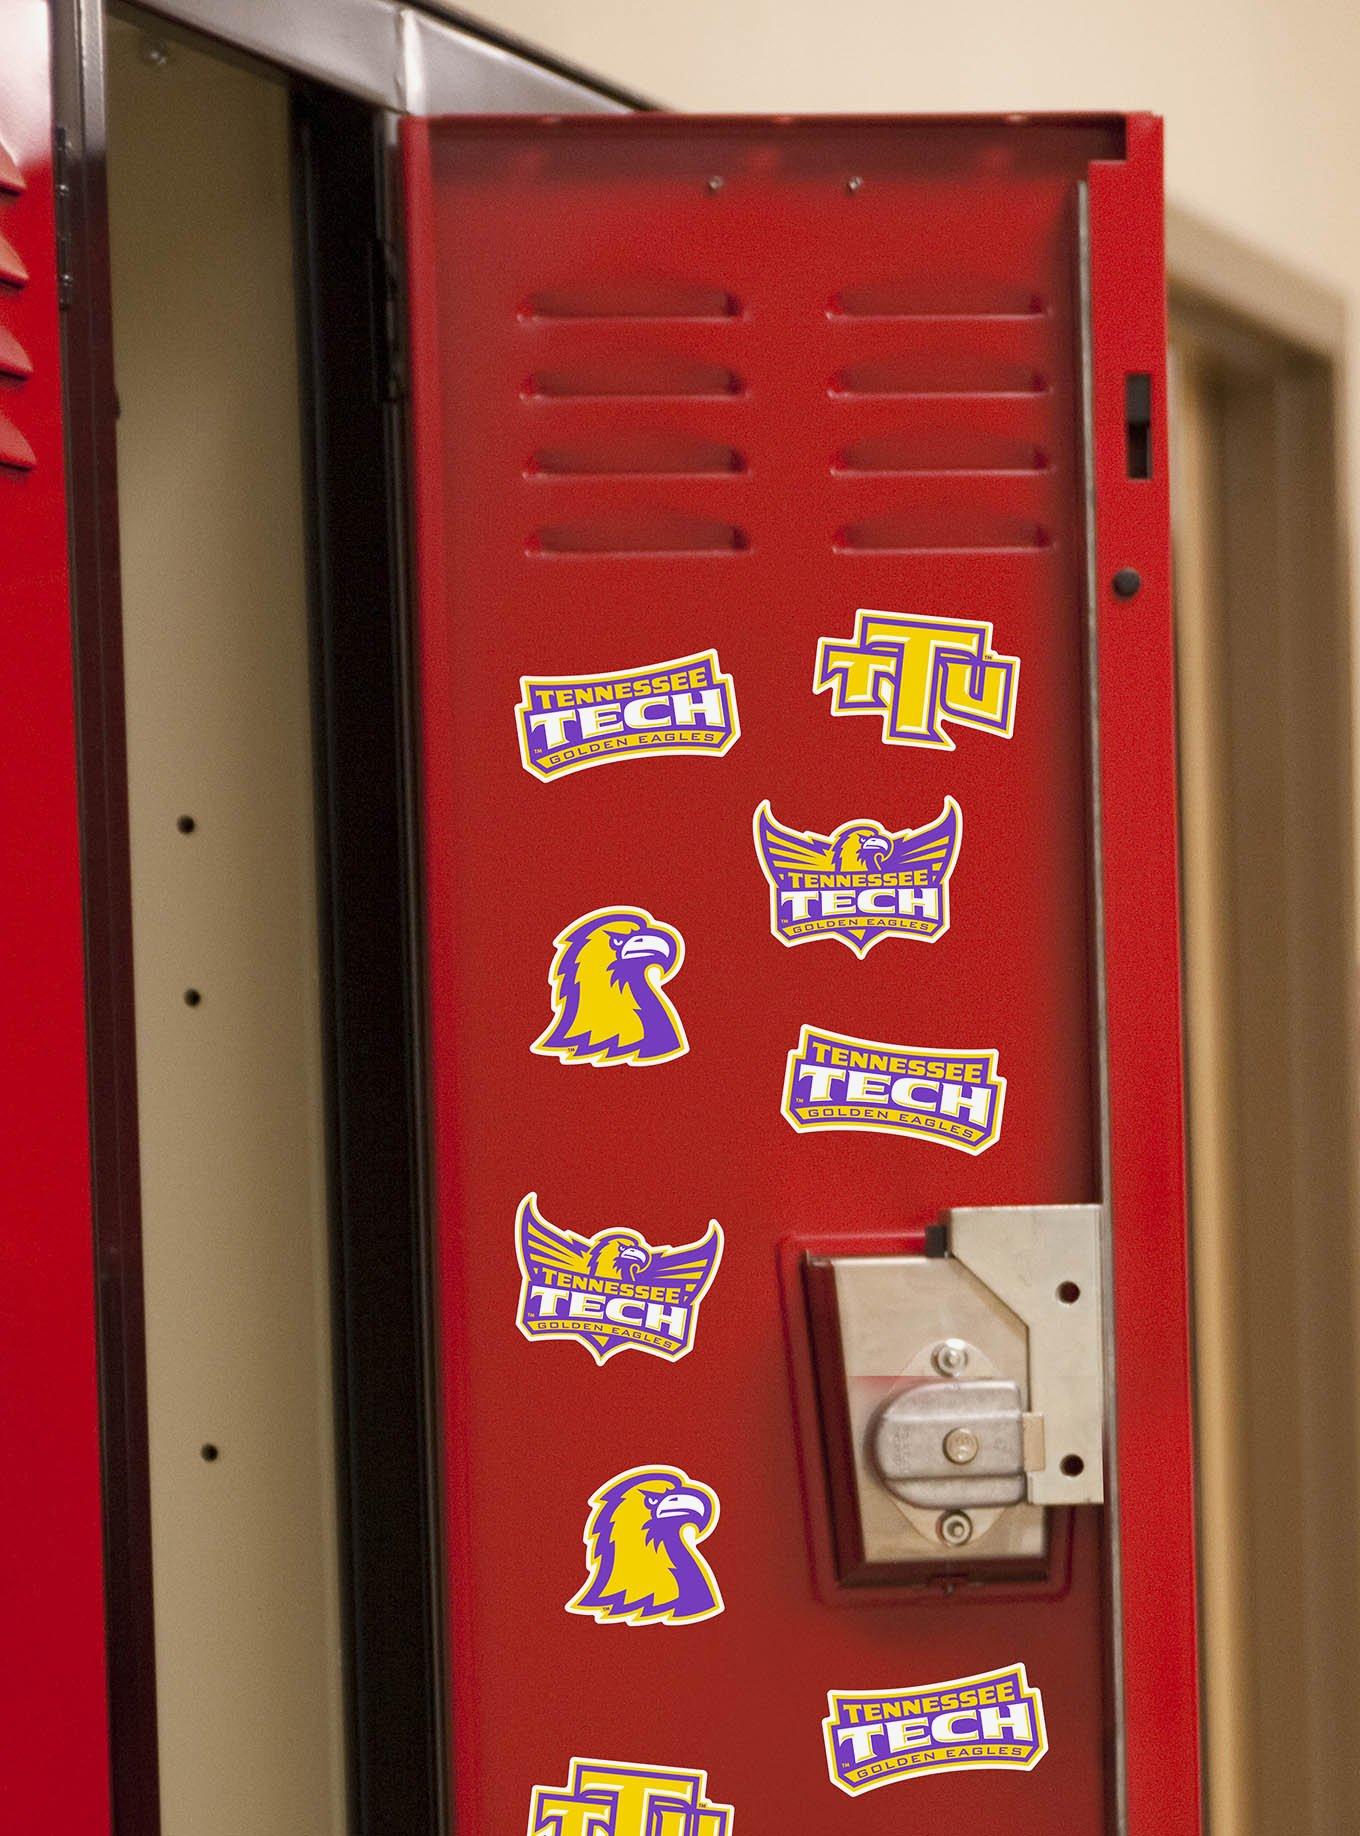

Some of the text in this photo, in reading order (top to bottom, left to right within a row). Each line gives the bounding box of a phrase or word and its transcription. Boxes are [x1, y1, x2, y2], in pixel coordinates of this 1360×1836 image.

[535, 667, 708, 709] TENNESSEE
[820, 616, 1013, 742] TTU
[529, 688, 725, 750] TECH
[550, 733, 715, 765] GOLDEN EAGLES
[788, 869, 928, 888] TENNESSEE
[781, 888, 938, 921] TECH
[793, 918, 929, 933] GOLDEN EAGLES
[812, 1041, 982, 1083] TENNESSEE
[799, 1064, 992, 1128] TECH
[808, 1108, 973, 1138] GOLDEN EAGLES
[542, 1268, 681, 1304] TENNESSEE
[530, 1285, 688, 1341] TECH
[538, 1322, 673, 1349] GOLDEN EAGLES
[843, 1681, 1015, 1723] TENNESSEE
[838, 1702, 1033, 1763] TECH
[857, 1747, 1022, 1779] GOLDEN EAGLES
